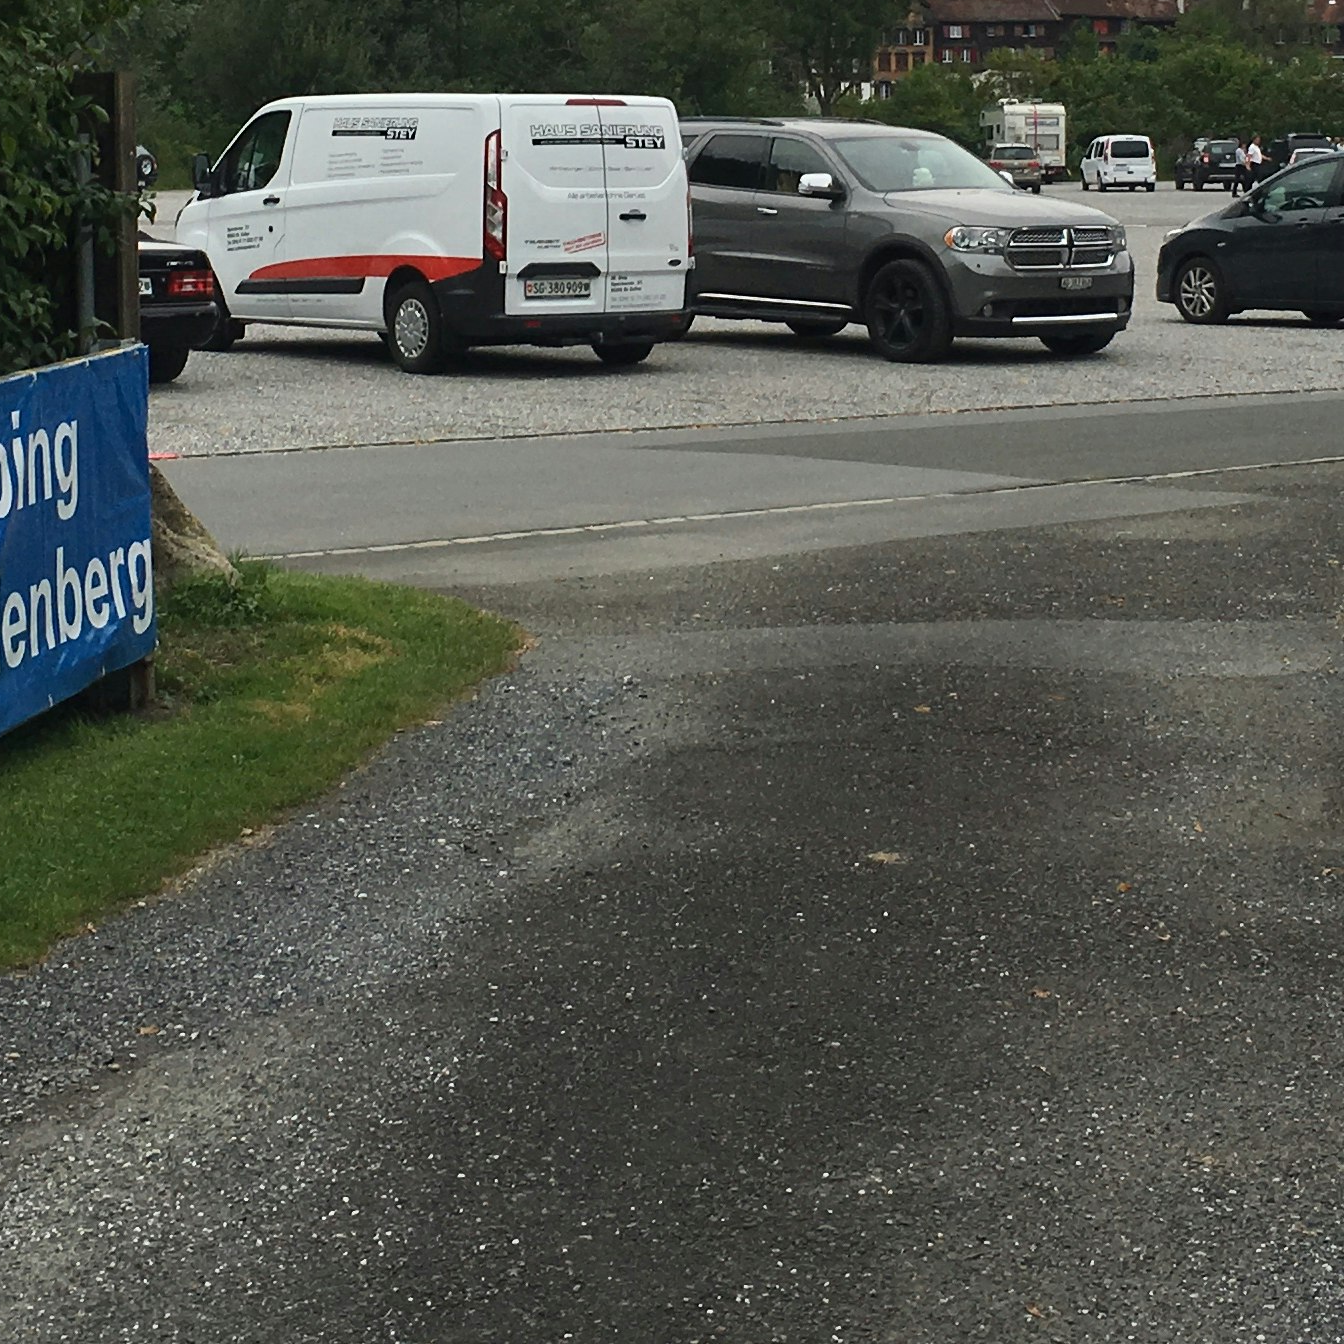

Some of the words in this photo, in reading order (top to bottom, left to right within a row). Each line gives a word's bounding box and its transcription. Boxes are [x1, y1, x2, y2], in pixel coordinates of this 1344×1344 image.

[386, 128, 416, 139] STEY
[530, 124, 577, 137] HAUS
[580, 124, 664, 137] SANIERUNG
[625, 136, 664, 148] STEY
